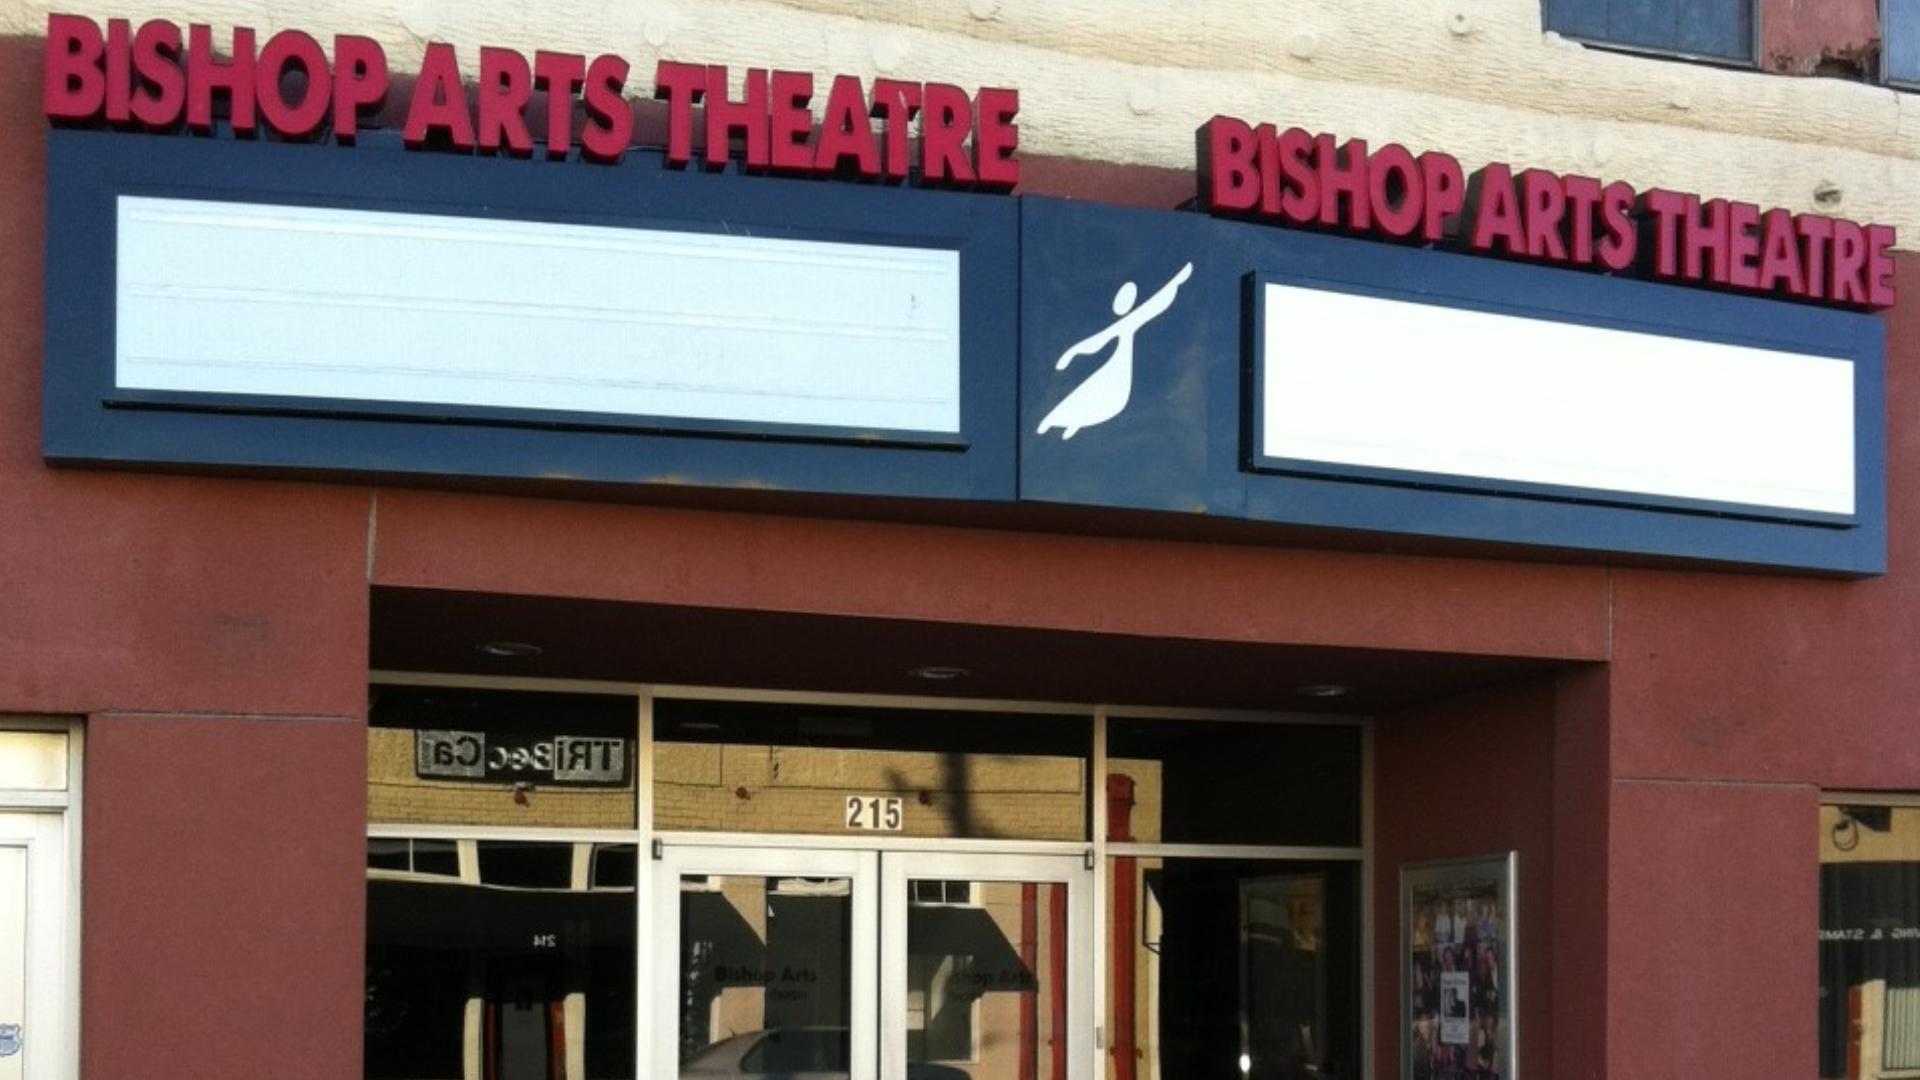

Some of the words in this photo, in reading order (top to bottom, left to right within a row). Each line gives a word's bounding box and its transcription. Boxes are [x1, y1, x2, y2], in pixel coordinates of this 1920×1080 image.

[45, 14, 389, 145] BISHOP
[404, 42, 634, 162] ARTS
[657, 60, 1020, 192] THEATRE
[1209, 115, 1465, 240] BISHOP
[1474, 162, 1637, 270] ARTS
[1646, 188, 1896, 306] THEATRE
[848, 796, 900, 829] 215
[714, 965, 773, 984] Bishop
[780, 965, 817, 982] Arts
